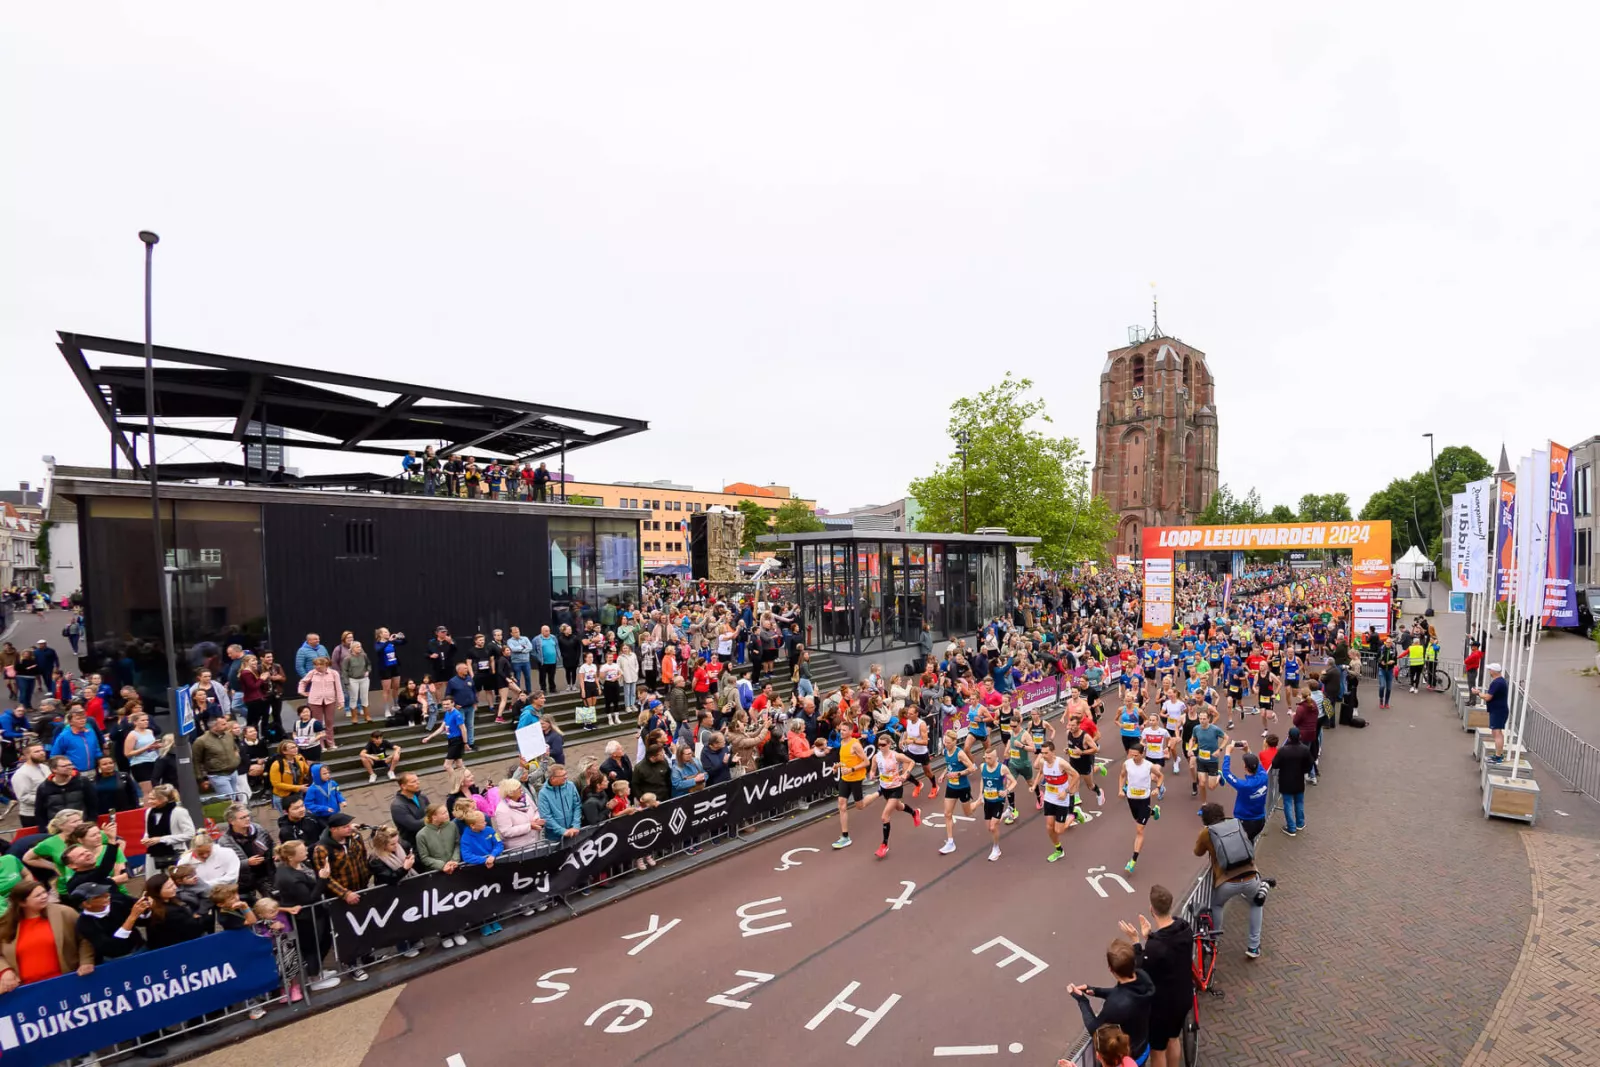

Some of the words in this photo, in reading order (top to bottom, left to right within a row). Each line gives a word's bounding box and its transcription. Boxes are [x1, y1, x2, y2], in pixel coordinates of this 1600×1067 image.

[1159, 530, 1202, 547] LOOP
[1203, 526, 1326, 547] LEEUWARDEN
[1328, 525, 1371, 545] 2024
[742, 771, 820, 804] Welkom
[821, 761, 841, 782] bj
[627, 825, 663, 843] NISSAN
[691, 810, 729, 827] DACIA
[345, 876, 502, 936] Welkom
[511, 868, 551, 894] bij
[558, 832, 618, 871] ABD
[20, 994, 134, 1044] DIJKSTRA
